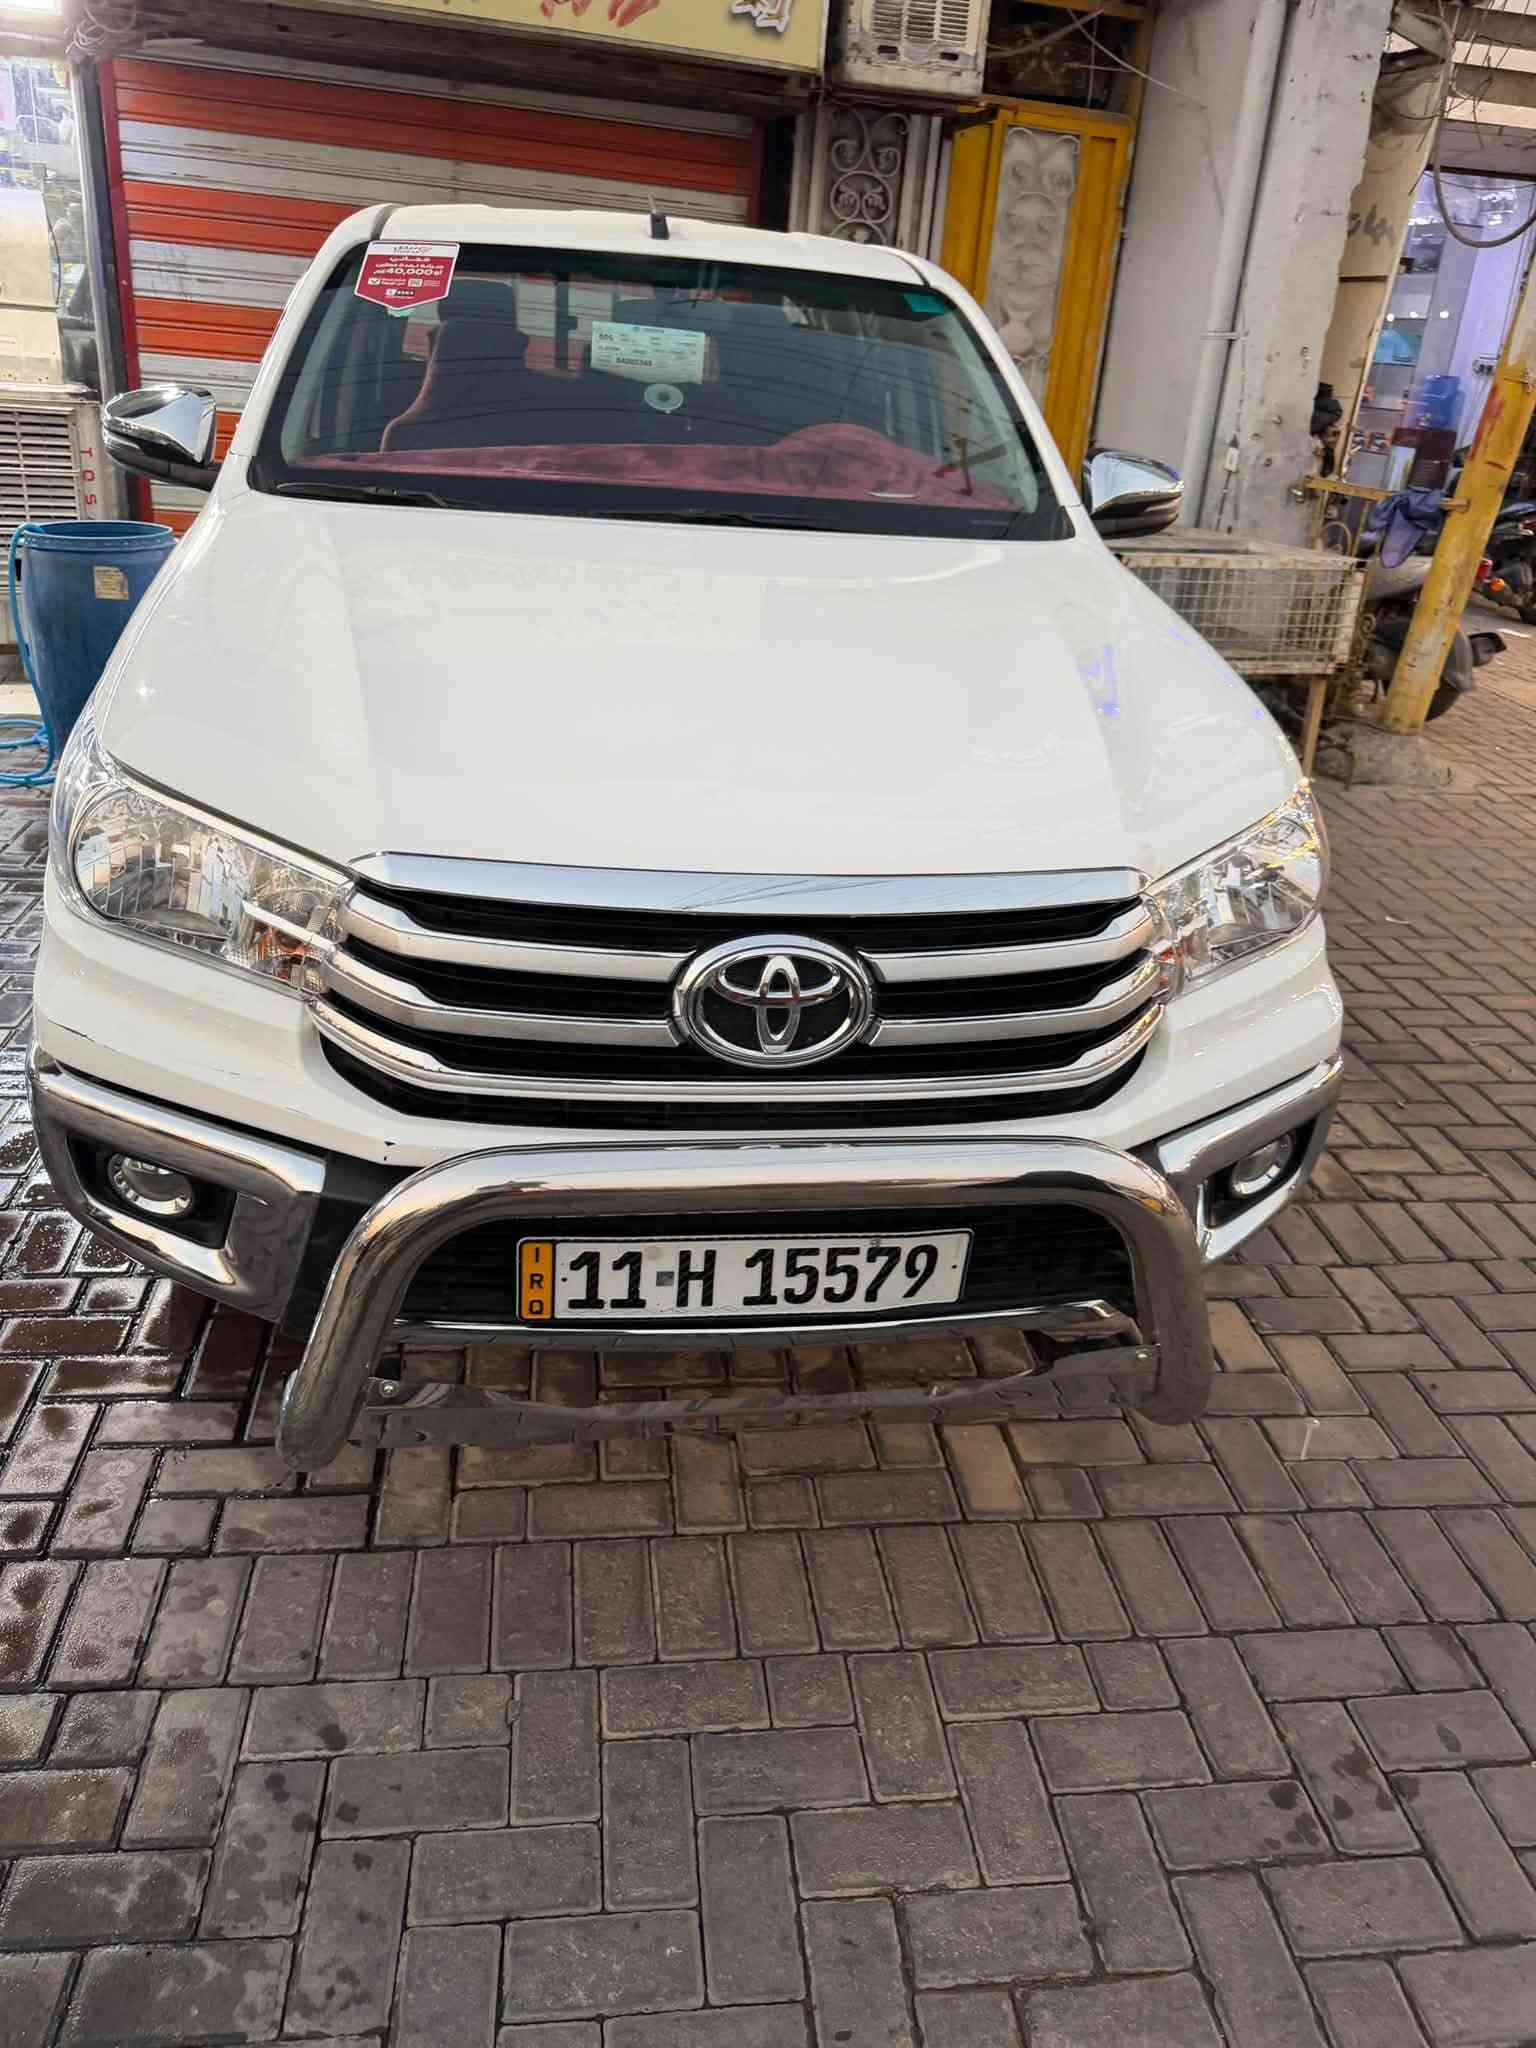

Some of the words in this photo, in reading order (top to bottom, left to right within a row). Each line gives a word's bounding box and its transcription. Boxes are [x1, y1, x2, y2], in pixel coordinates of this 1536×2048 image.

[81, 447, 98, 520] TOS
[568, 1250, 646, 1310] 11
[676, 1249, 716, 1307] H
[743, 1243, 939, 1307] 15579
